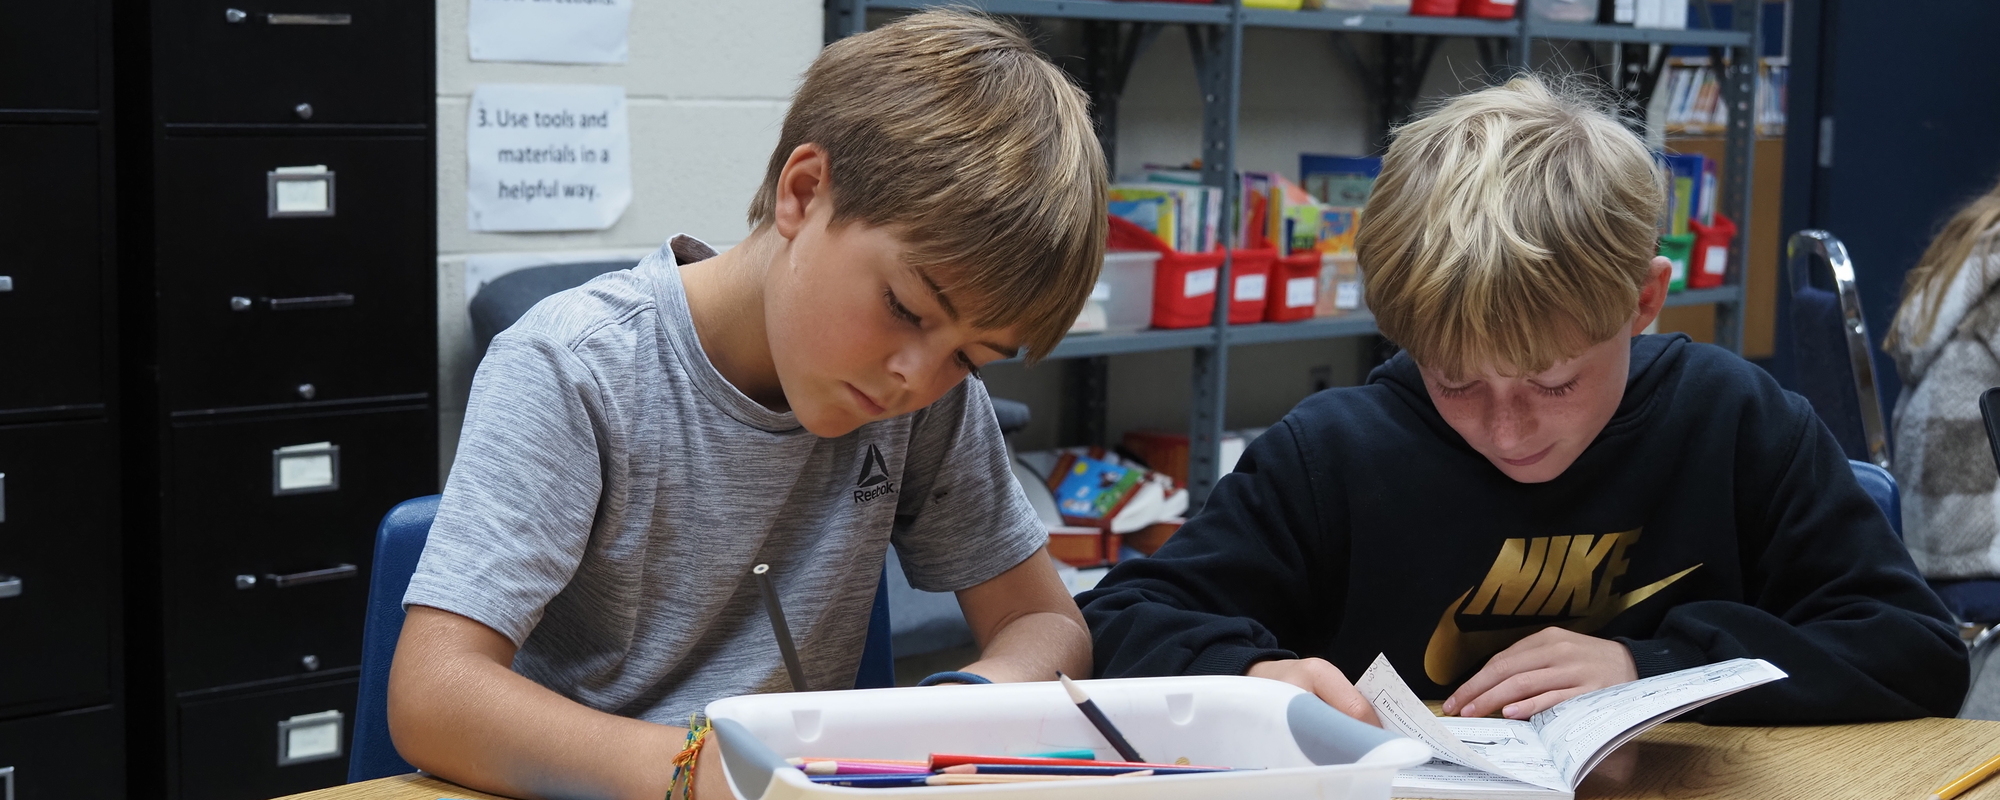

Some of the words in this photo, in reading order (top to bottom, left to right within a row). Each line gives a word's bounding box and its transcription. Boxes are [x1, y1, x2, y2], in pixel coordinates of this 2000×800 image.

[477, 109, 493, 127] 3.
[497, 109, 529, 128] Use
[534, 110, 574, 129] tools
[579, 109, 608, 129] and
[498, 145, 576, 164] materials
[580, 145, 597, 164] in
[600, 150, 611, 164] a
[498, 179, 558, 203] helpful
[563, 184, 600, 203] way.
[1462, 527, 1642, 615] NIKE
[1382, 698, 1394, 713] The
